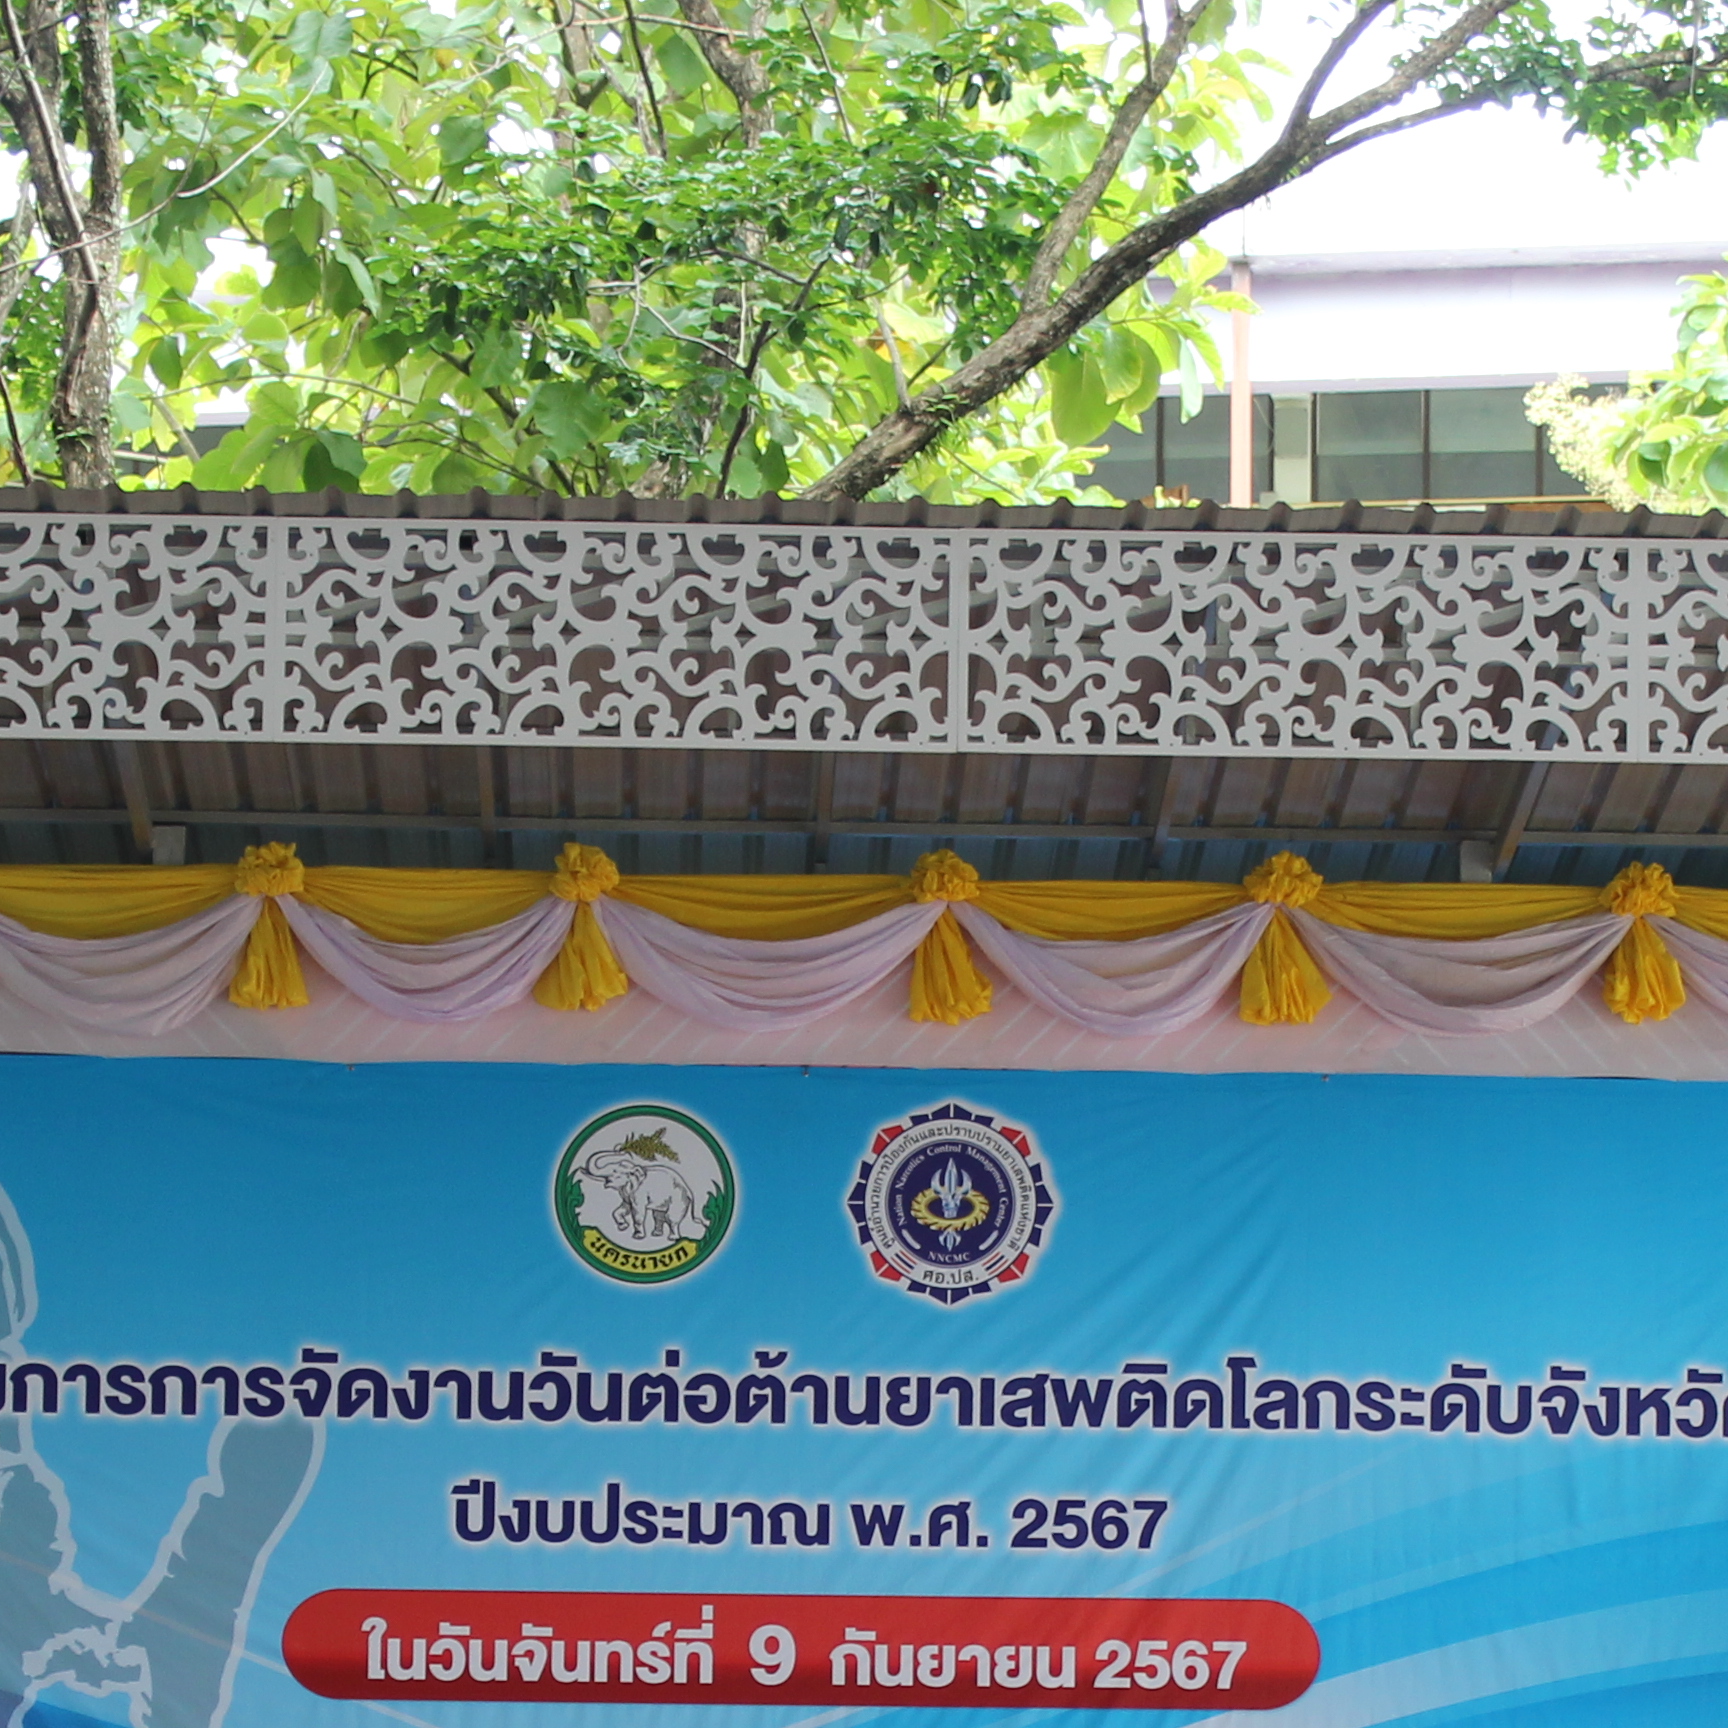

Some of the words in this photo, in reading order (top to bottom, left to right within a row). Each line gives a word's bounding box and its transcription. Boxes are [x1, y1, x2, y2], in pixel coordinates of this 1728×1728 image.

[926, 1143, 963, 1157] Control
[590, 1236, 689, 1271] นครนายก
[927, 1250, 972, 1264] NNCMC
[922, 1268, 980, 1285] ศอ.ปส.
[451, 1479, 830, 1546] ปีงบประมาณ
[850, 1501, 988, 1548] พ.ศ.
[1011, 1498, 1168, 1549] 2567
[361, 1605, 714, 1684] ในวันจันทร์ที่
[749, 1624, 796, 1686] 9
[829, 1627, 1076, 1689] กันยายน
[1093, 1639, 1247, 1690] 2567
